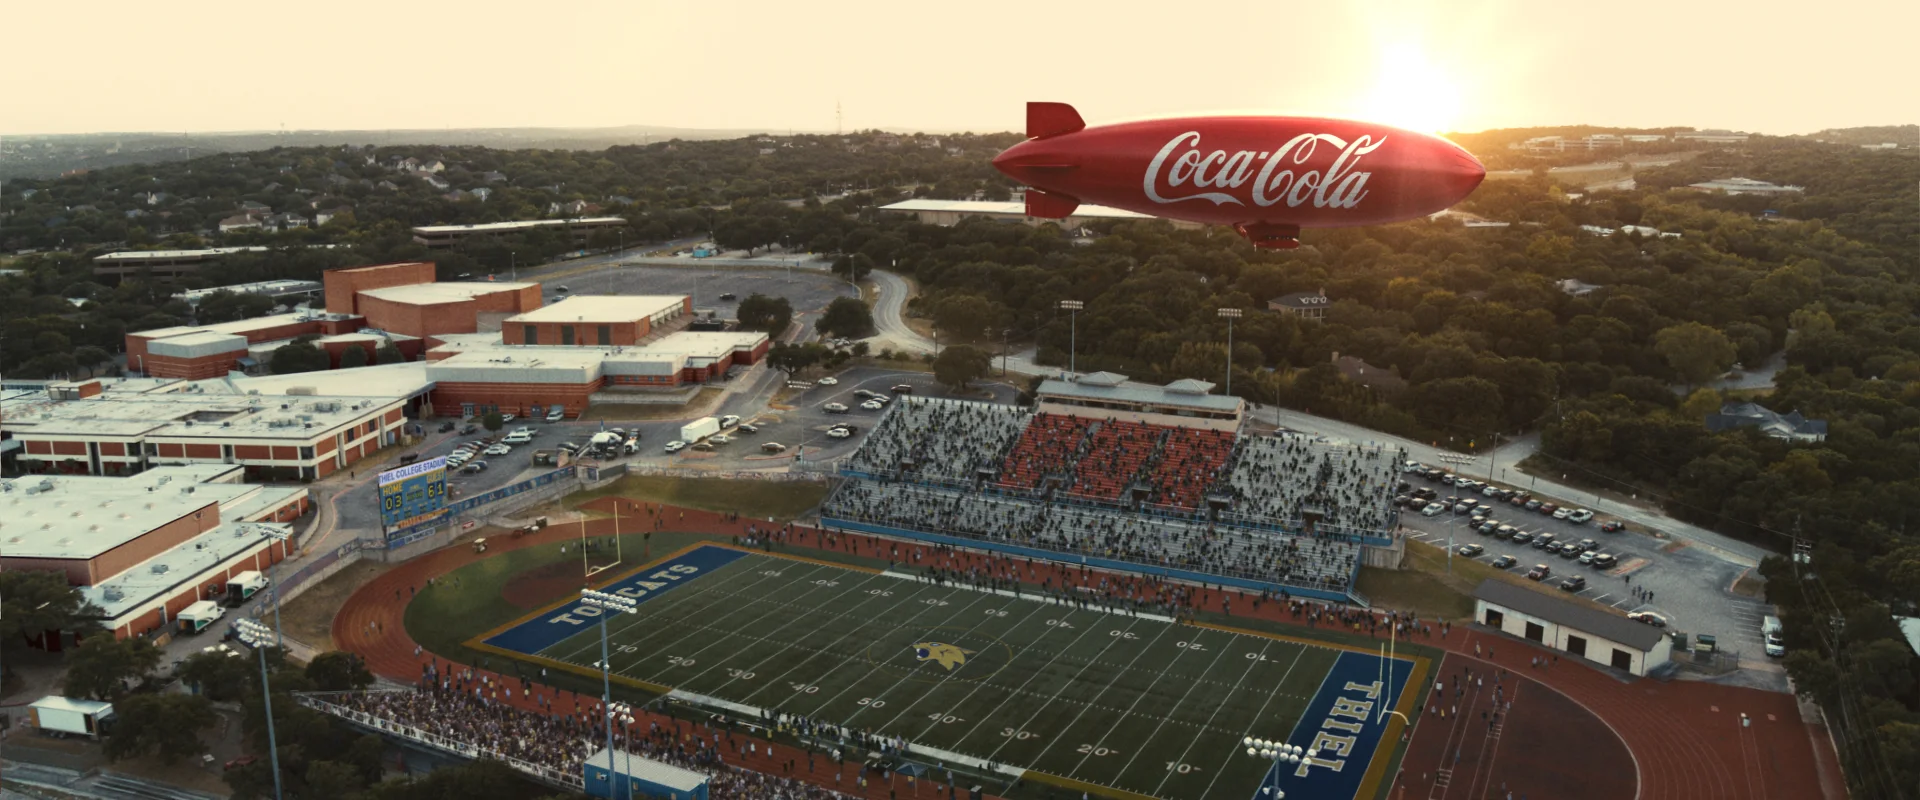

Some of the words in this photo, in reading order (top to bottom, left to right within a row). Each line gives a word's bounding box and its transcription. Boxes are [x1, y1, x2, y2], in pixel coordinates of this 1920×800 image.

[1143, 130, 1387, 209] Coca-Cola
[379, 472, 395, 484] THIEL
[396, 464, 423, 479] COLLEGE
[423, 457, 446, 472] STADIUM
[427, 468, 444, 483] GUEST
[383, 481, 403, 497] HOME
[428, 483, 444, 497] 61
[386, 495, 402, 510] 03
[548, 564, 698, 625] TOCATS
[984, 609, 1009, 617] 50
[1046, 619, 1070, 628] 40
[1109, 630, 1136, 640] 30
[616, 644, 638, 653] 10
[1176, 641, 1203, 651] 20
[668, 656, 696, 667] 20
[1245, 652, 1268, 662] 10
[728, 669, 756, 680] 30
[792, 684, 819, 694] 40
[857, 697, 886, 709] 50
[927, 713, 957, 724] 40
[1000, 727, 1031, 740] 30
[1294, 681, 1384, 777] THIEL
[1076, 744, 1109, 756] 20
[1165, 761, 1191, 774] 10
